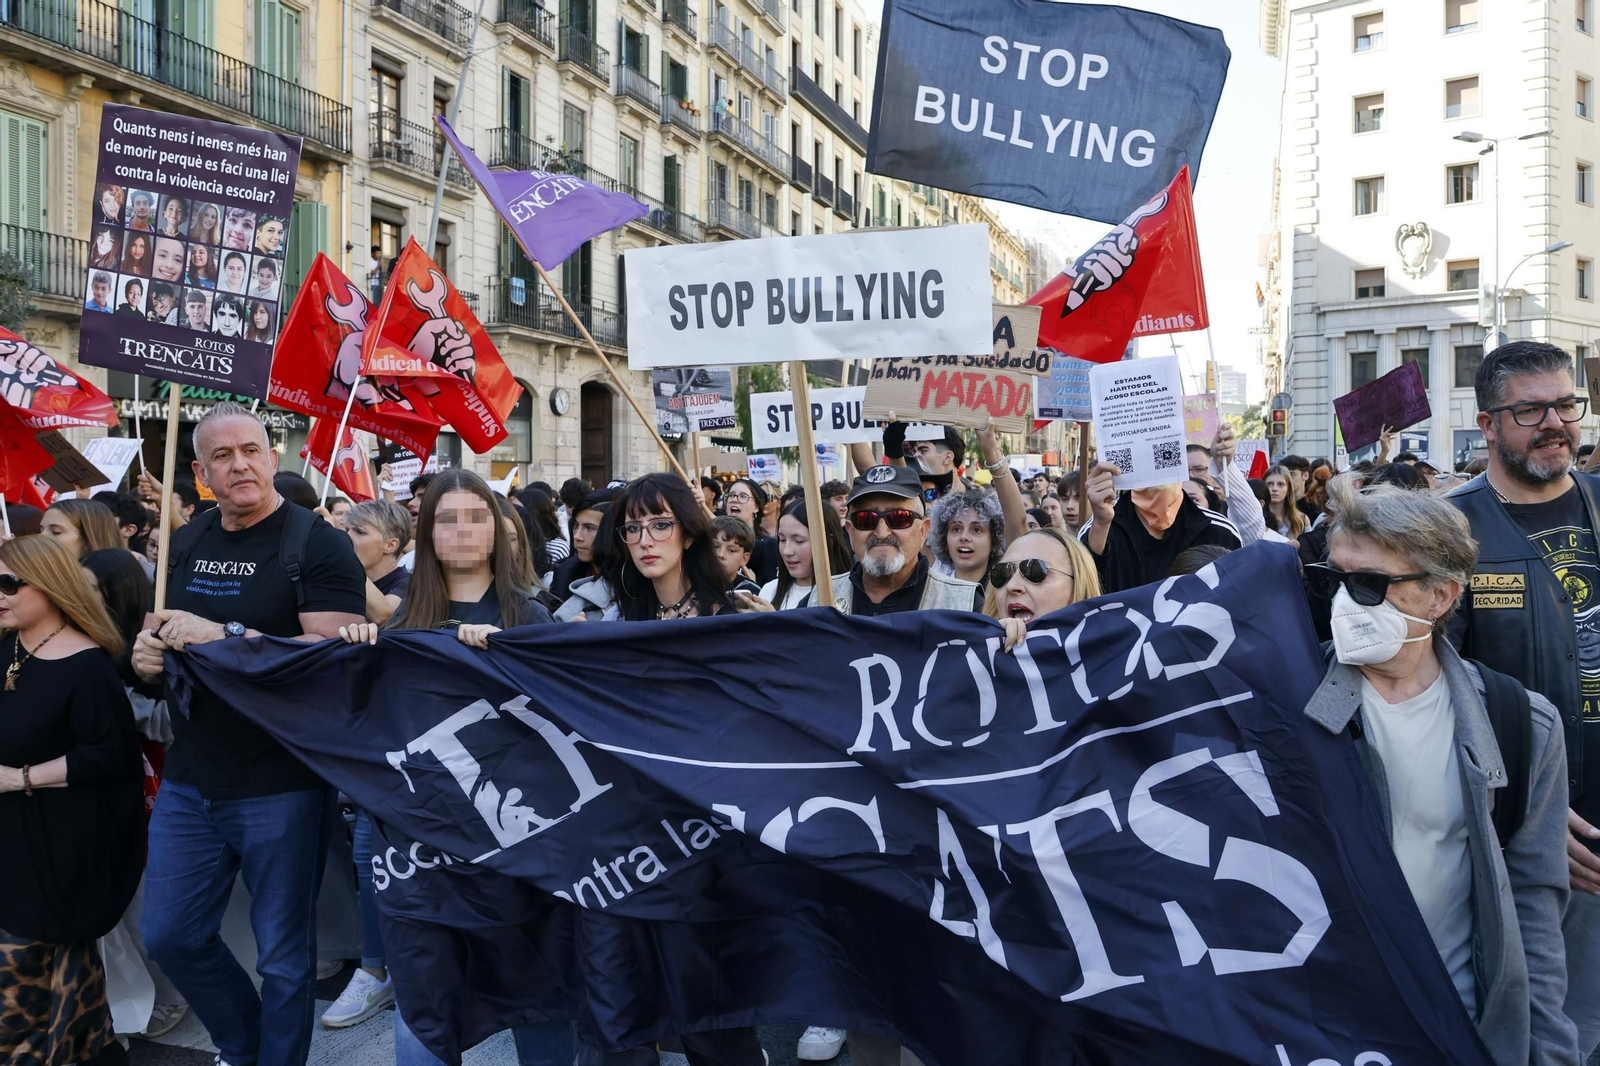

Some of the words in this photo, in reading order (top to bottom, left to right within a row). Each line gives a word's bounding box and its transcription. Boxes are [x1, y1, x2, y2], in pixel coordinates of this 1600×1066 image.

[980, 35, 1109, 91] STOP
[113, 118, 156, 138] Quants
[160, 128, 188, 144] nens
[190, 132, 195, 145] i
[197, 136, 234, 152] nenes
[236, 142, 261, 157] més
[264, 144, 287, 162] han
[914, 85, 1156, 168] BULLYING
[106, 138, 121, 153] de
[124, 144, 157, 160] morir
[159, 151, 203, 170] perquè
[205, 160, 218, 172] es
[221, 161, 242, 176] faci
[246, 168, 268, 181] una
[270, 168, 290, 184] llei
[115, 164, 152, 182] contra
[156, 168, 167, 184] la
[169, 172, 223, 194] violència
[226, 184, 276, 204] escolar?
[668, 281, 754, 331] STOP
[766, 269, 944, 326] BULLYING
[120, 338, 233, 375] TRENCATS
[194, 338, 236, 354] ROTOS
[886, 361, 921, 382] han
[1110, 383, 1141, 393] HARTOS
[1114, 374, 1152, 385] ESTAMOS
[919, 370, 1030, 417] MATADO
[1104, 392, 1129, 401] ACOSO
[1130, 387, 1168, 397] ESCOLAR
[700, 417, 734, 428] TRENCATS
[767, 402, 823, 433] STP
[193, 560, 256, 576] TRENCATS
[1475, 596, 1522, 606] SEGURIDAD
[847, 566, 1236, 755] ROTOS
